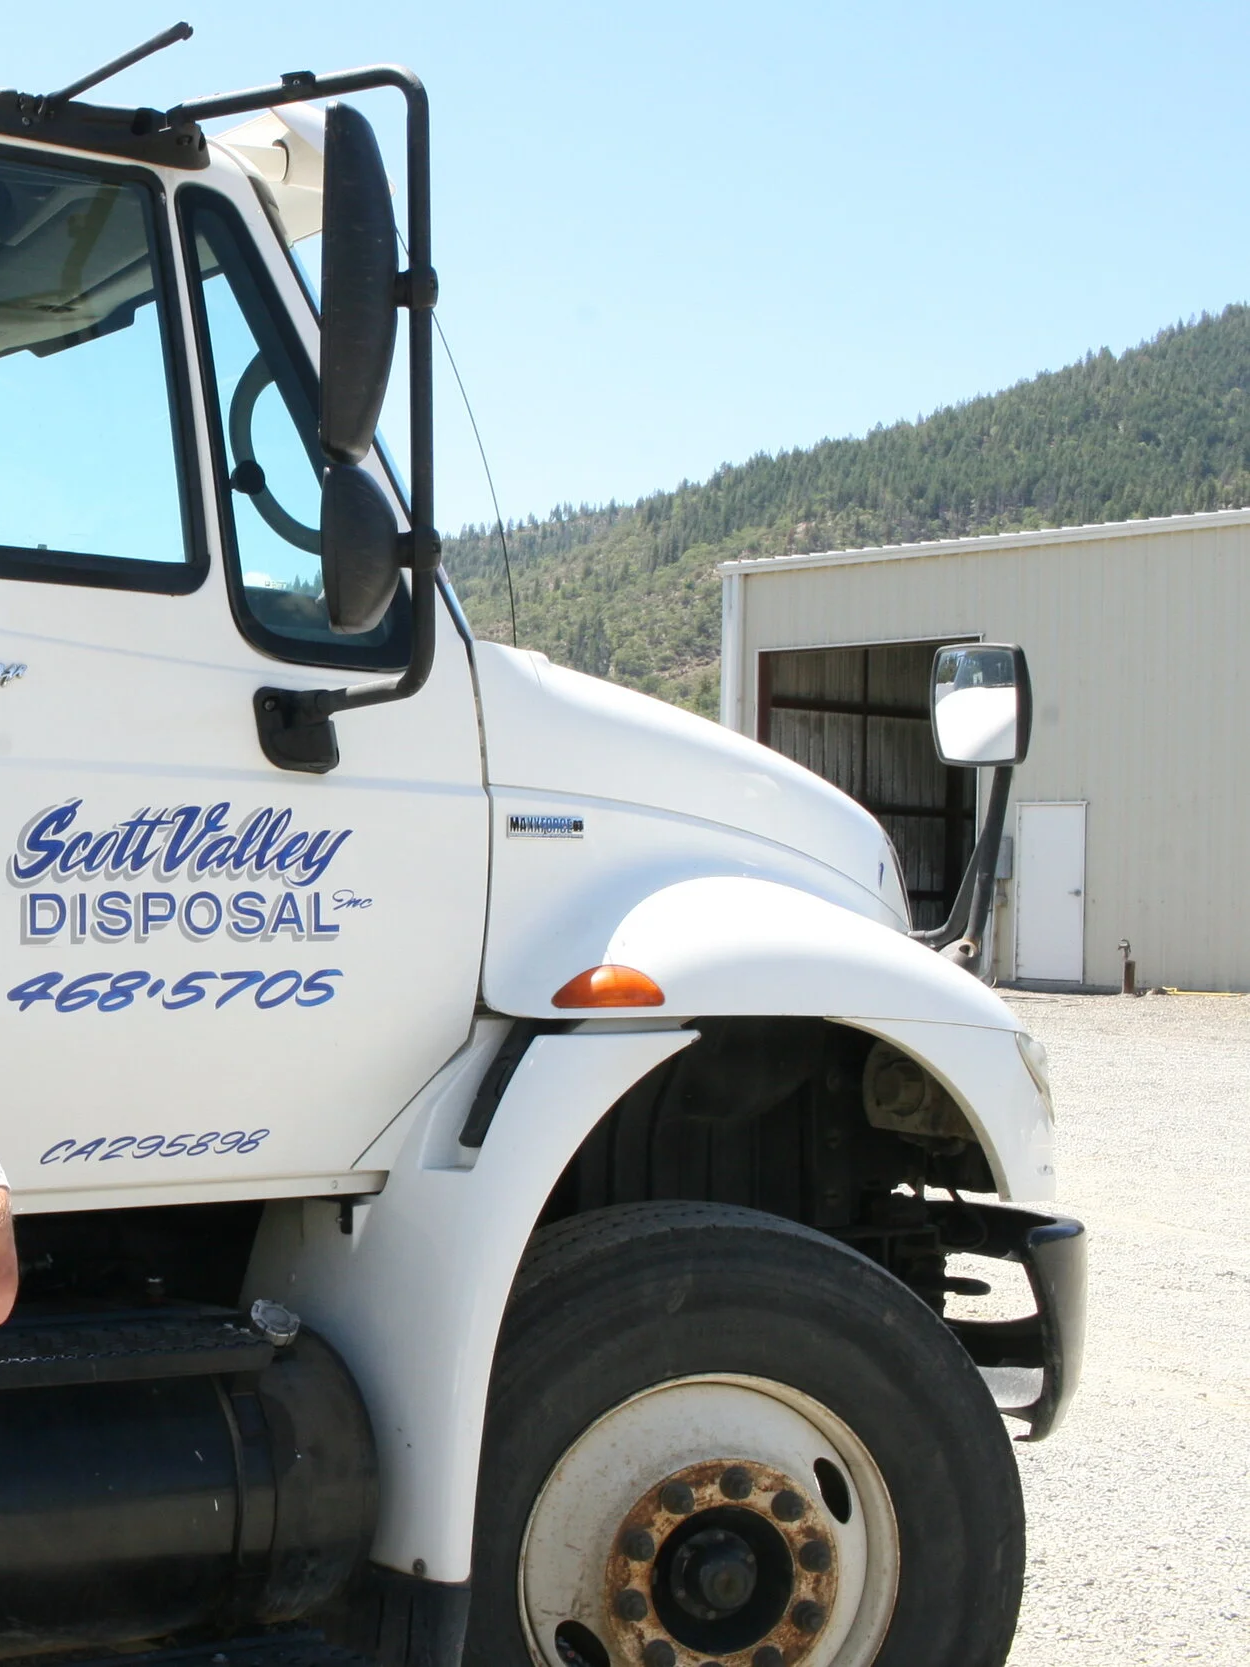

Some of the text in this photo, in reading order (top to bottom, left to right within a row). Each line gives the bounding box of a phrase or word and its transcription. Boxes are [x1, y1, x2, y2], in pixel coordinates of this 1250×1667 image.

[7, 797, 354, 889] Scott Valley
[21, 889, 342, 944] DISPOSAL
[40, 1128, 270, 1165] CA295898
